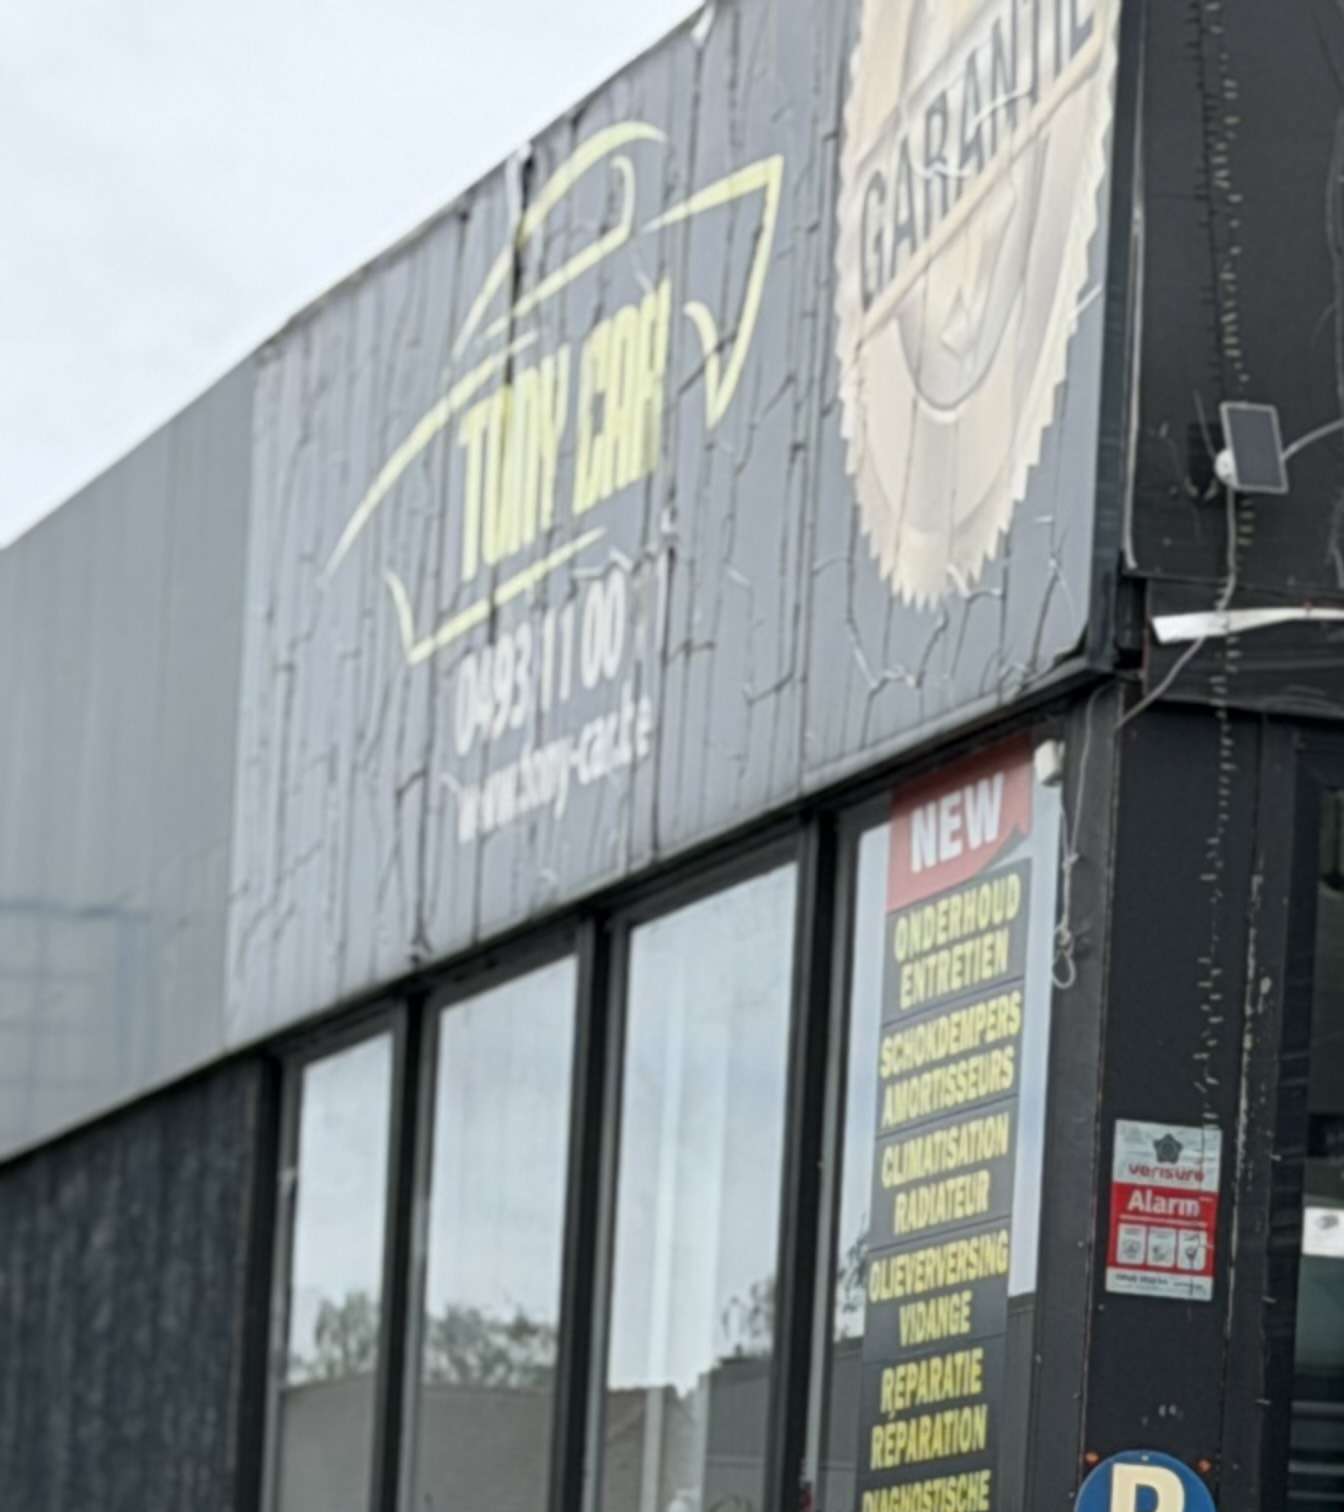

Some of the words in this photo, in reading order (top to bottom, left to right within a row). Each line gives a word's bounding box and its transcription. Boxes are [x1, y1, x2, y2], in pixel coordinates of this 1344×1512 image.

[910, 772, 1004, 873] NEW
[895, 873, 1021, 961] ONDERHOUD
[901, 930, 1009, 1009] ENTRETIEN
[881, 991, 1022, 1078] SCHOKDEMPERS
[881, 1046, 1014, 1129] AMORTISSEURS
[882, 1112, 1010, 1188] CLIMATISATION
[1128, 1160, 1205, 1183] verisure
[894, 1171, 990, 1235] RADIATEUR
[1127, 1188, 1200, 1217] Alarm
[869, 1230, 1009, 1303] OLIEVERVERSING
[900, 1291, 973, 1347] VIDANGE
[881, 1348, 983, 1413] REPARATIE
